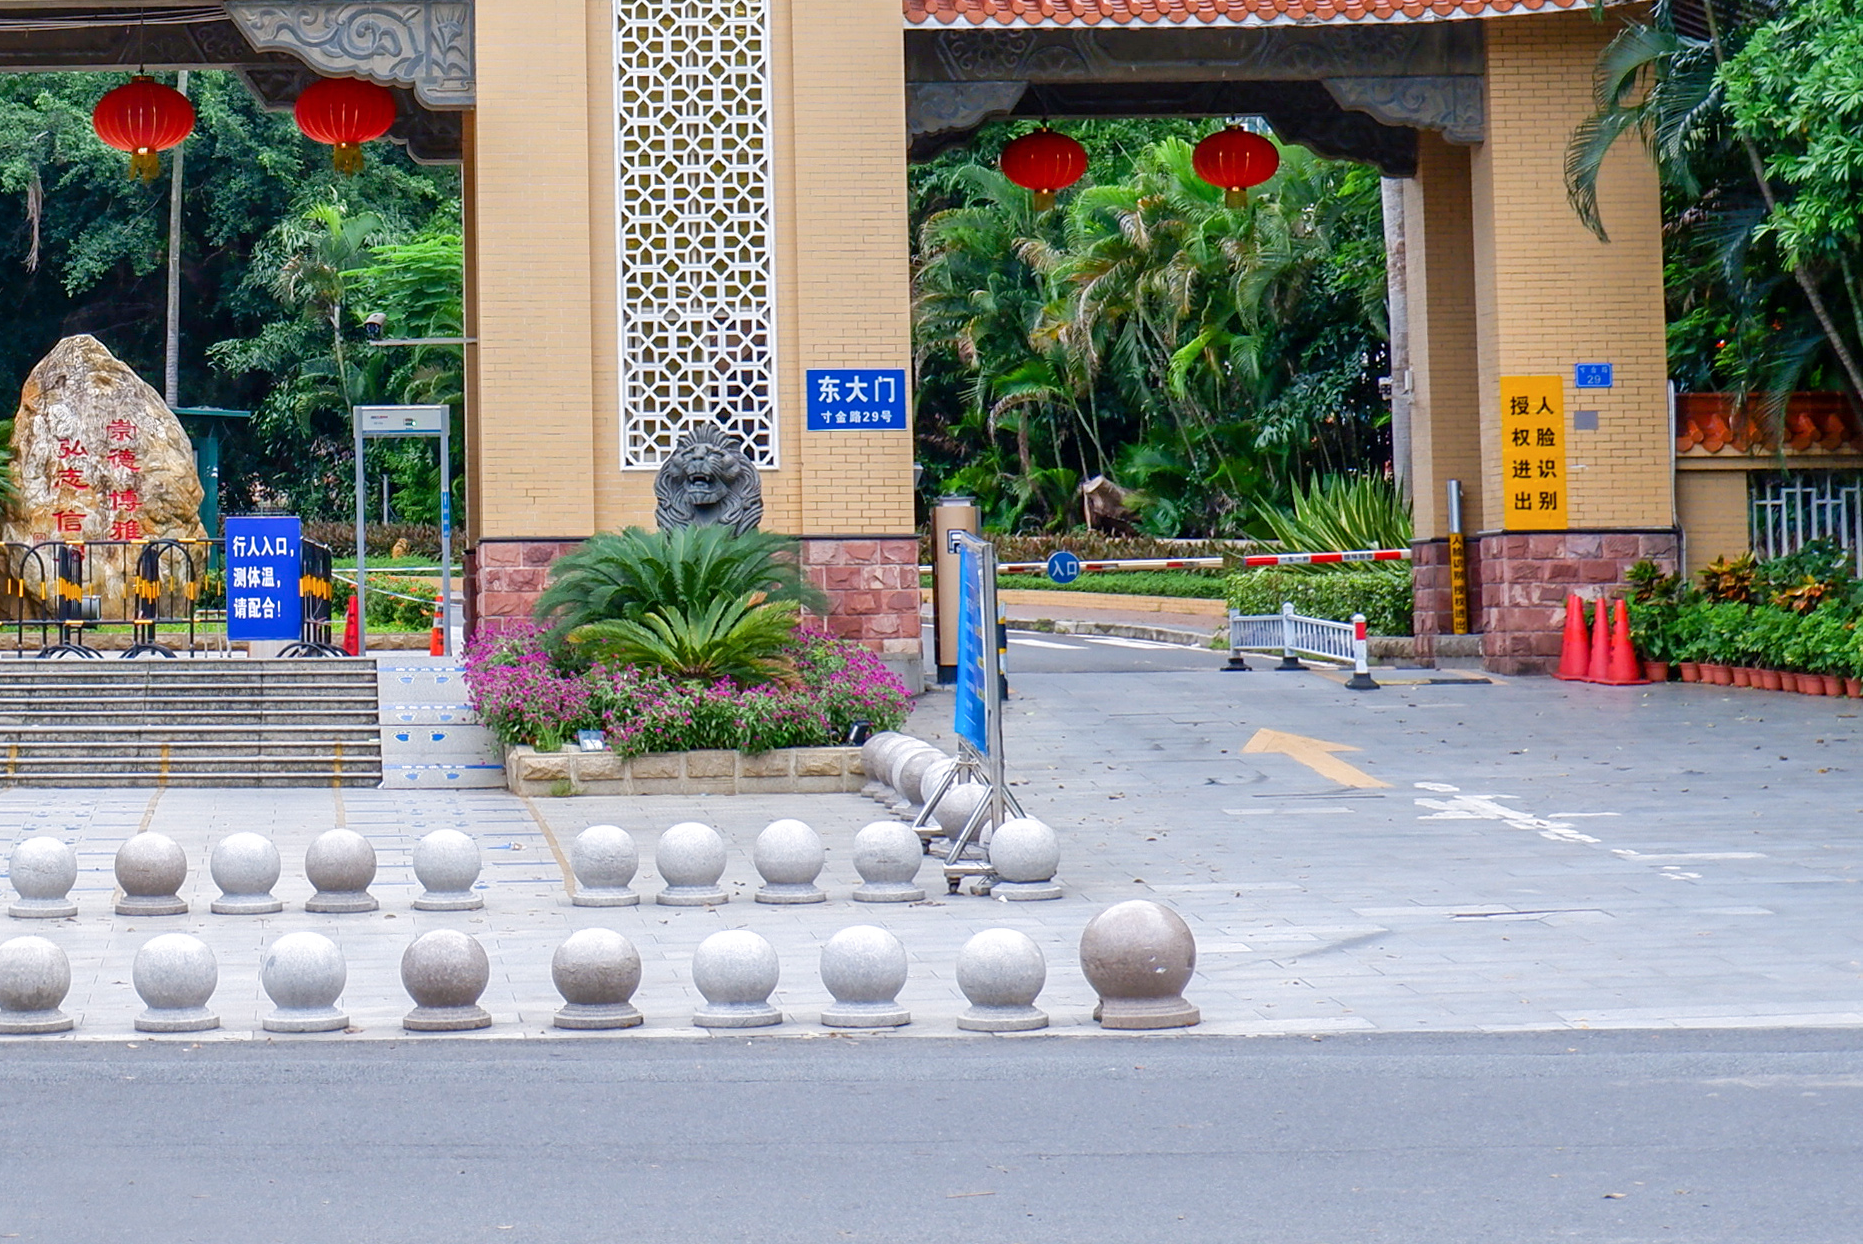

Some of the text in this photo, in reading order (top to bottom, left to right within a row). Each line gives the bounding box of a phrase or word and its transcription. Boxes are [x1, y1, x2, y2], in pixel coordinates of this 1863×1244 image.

[818, 375, 895, 403] 东大门
[1587, 374, 1602, 384] 29
[820, 410, 892, 424] 寸金路29号
[1510, 396, 1532, 511] 授权进出
[1535, 396, 1557, 511] 人脸识别
[107, 418, 144, 541] 崇德博雅
[1052, 560, 1077, 576] 入口
